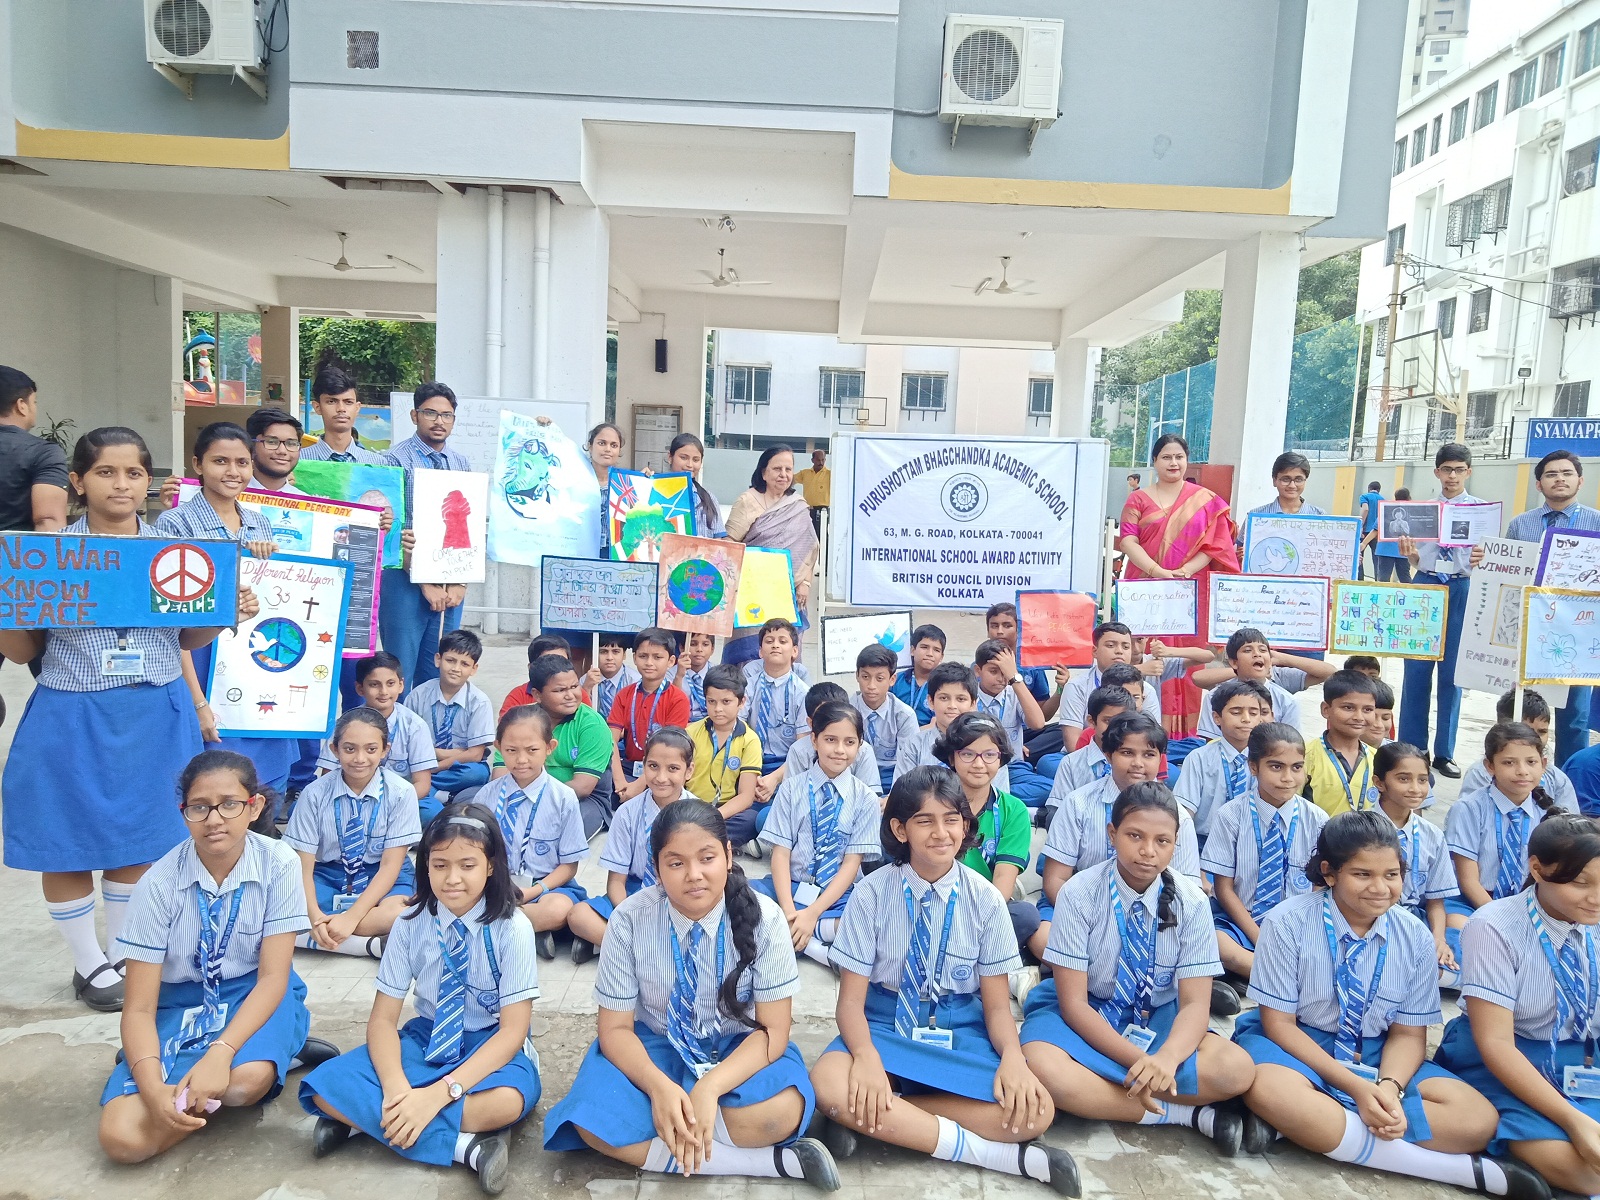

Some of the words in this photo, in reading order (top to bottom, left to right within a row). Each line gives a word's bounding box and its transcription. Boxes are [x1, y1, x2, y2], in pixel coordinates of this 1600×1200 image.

[859, 459, 924, 517] PURUSHOTTAM
[924, 446, 991, 472] BHAGCHANDKA
[992, 452, 1038, 488] ACADEMIC
[1035, 478, 1070, 521] SCHOOL
[235, 493, 300, 510] NTERNATIONAL
[304, 502, 330, 514] PEACE
[334, 506, 352, 516] DAY
[1290, 520, 1302, 530] पर
[884, 527, 898, 538] 63,
[901, 528, 912, 538] M.
[915, 528, 924, 538] G.
[928, 528, 956, 540] ROAD,
[960, 529, 1003, 539] KOLKATA
[1010, 530, 1044, 540] 700041
[1484, 542, 1523, 558] NOBLE
[862, 548, 937, 564] INTERNATIONAL
[940, 550, 979, 564] SCHOOL
[982, 552, 1016, 564] AWARD
[1018, 552, 1062, 566] ACTIVITY
[242, 560, 292, 585] Different
[295, 568, 334, 590] Religion
[1478, 562, 1520, 575] WINNER
[892, 573, 933, 584] BRITISH
[936, 574, 982, 585] COUNCIL
[986, 575, 1031, 586] DIVISION
[0, 576, 90, 600] KNOW
[938, 588, 984, 598] KOLKATA
[1120, 586, 1192, 602] Conversation
[151, 596, 215, 613] PEACE
[0, 602, 97, 626] PEACE
[1574, 609, 1594, 620] am
[1048, 622, 1072, 632] PEACE
[442, 1003, 454, 1014] PBAS
[454, 1020, 462, 1028] PBA
[434, 1033, 446, 1044] PBAS
[444, 1048, 456, 1058] PBAS
